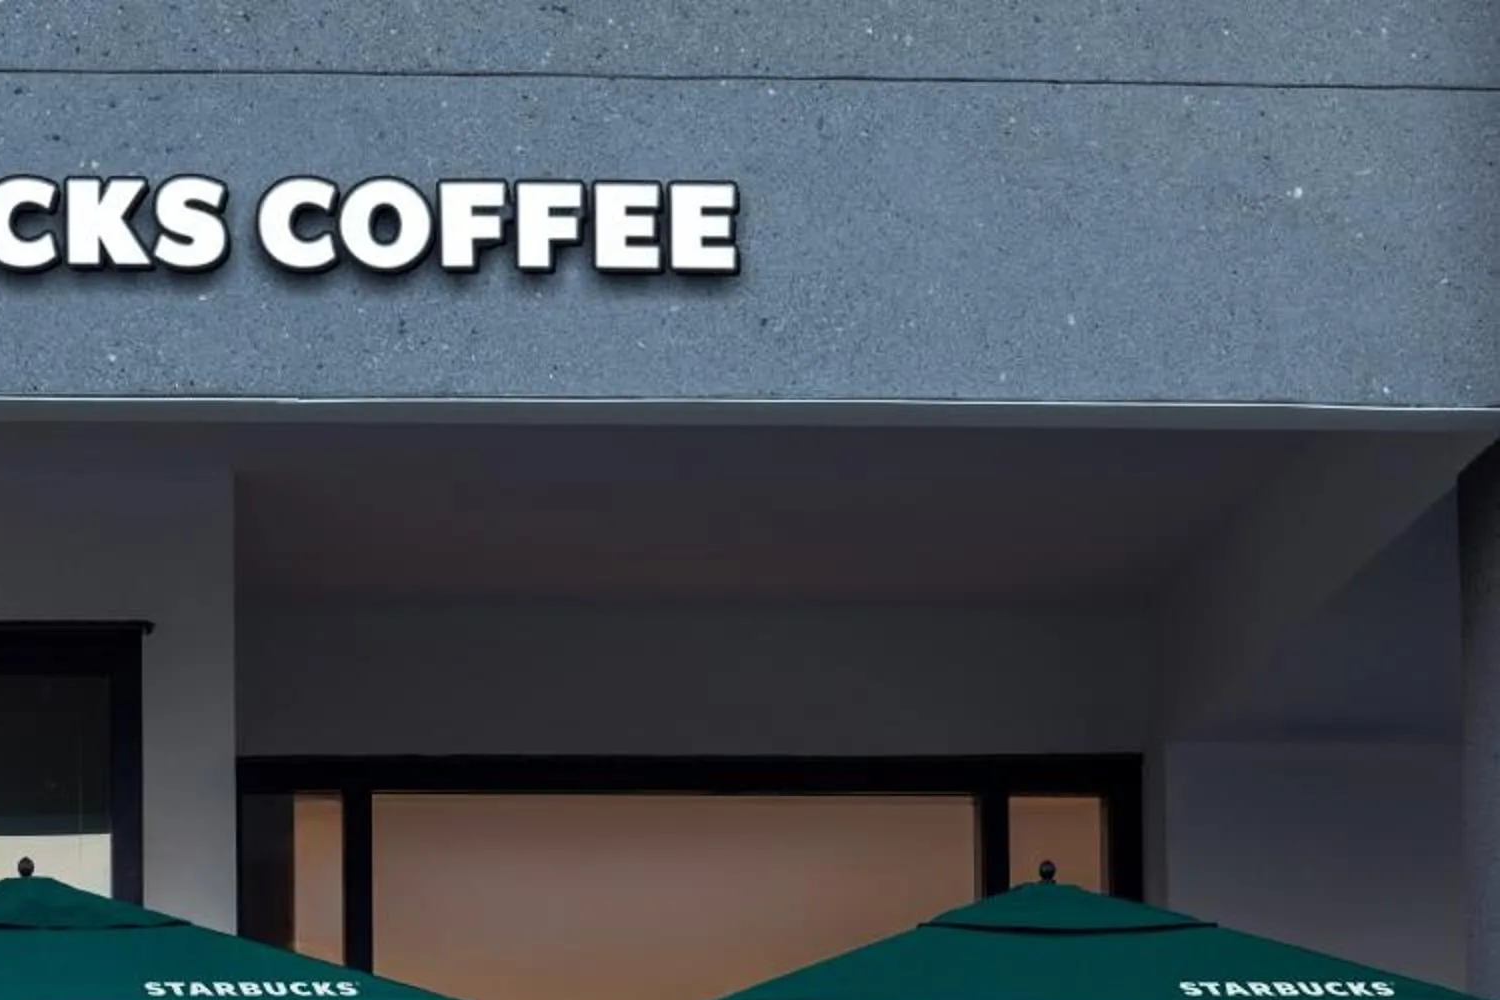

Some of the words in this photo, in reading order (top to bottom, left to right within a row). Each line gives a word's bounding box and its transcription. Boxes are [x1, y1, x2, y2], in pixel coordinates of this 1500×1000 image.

[257, 178, 737, 271] COFFEE
[143, 981, 359, 997] STARBUCKS
[1178, 981, 1396, 997] STARBUCKS
